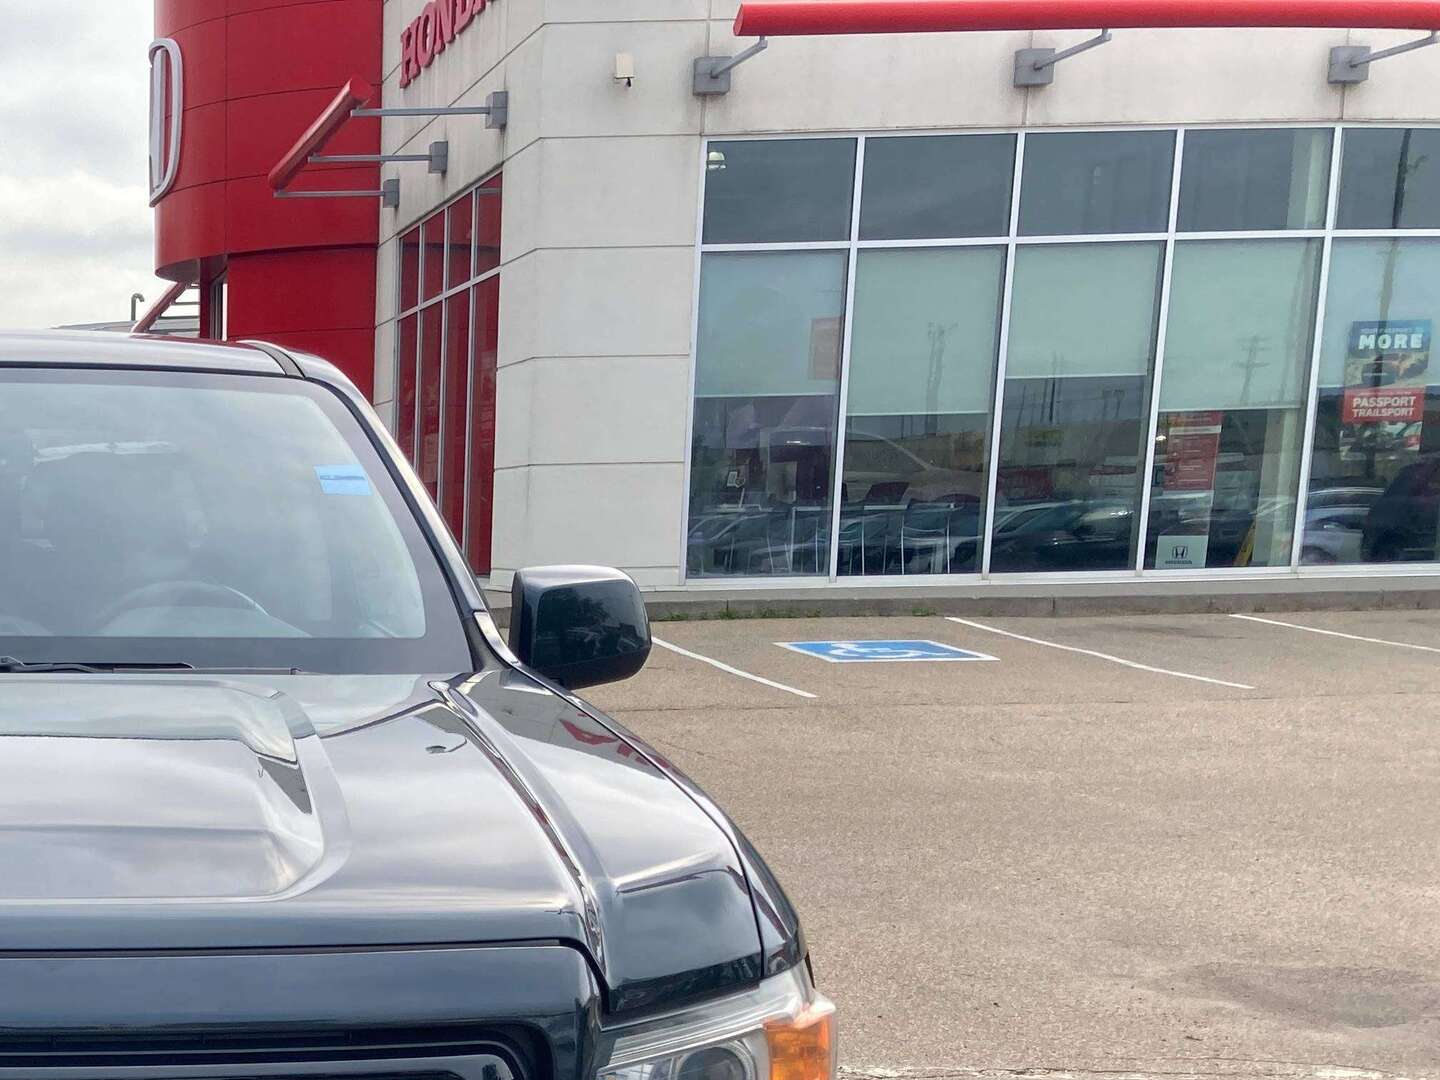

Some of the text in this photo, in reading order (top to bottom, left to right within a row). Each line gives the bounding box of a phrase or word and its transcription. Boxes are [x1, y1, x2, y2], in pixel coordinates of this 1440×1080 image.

[1358, 333, 1424, 350] MORE
[1352, 396, 1417, 408] PASSPORT
[1351, 407, 1415, 418] TRAILSPORT
